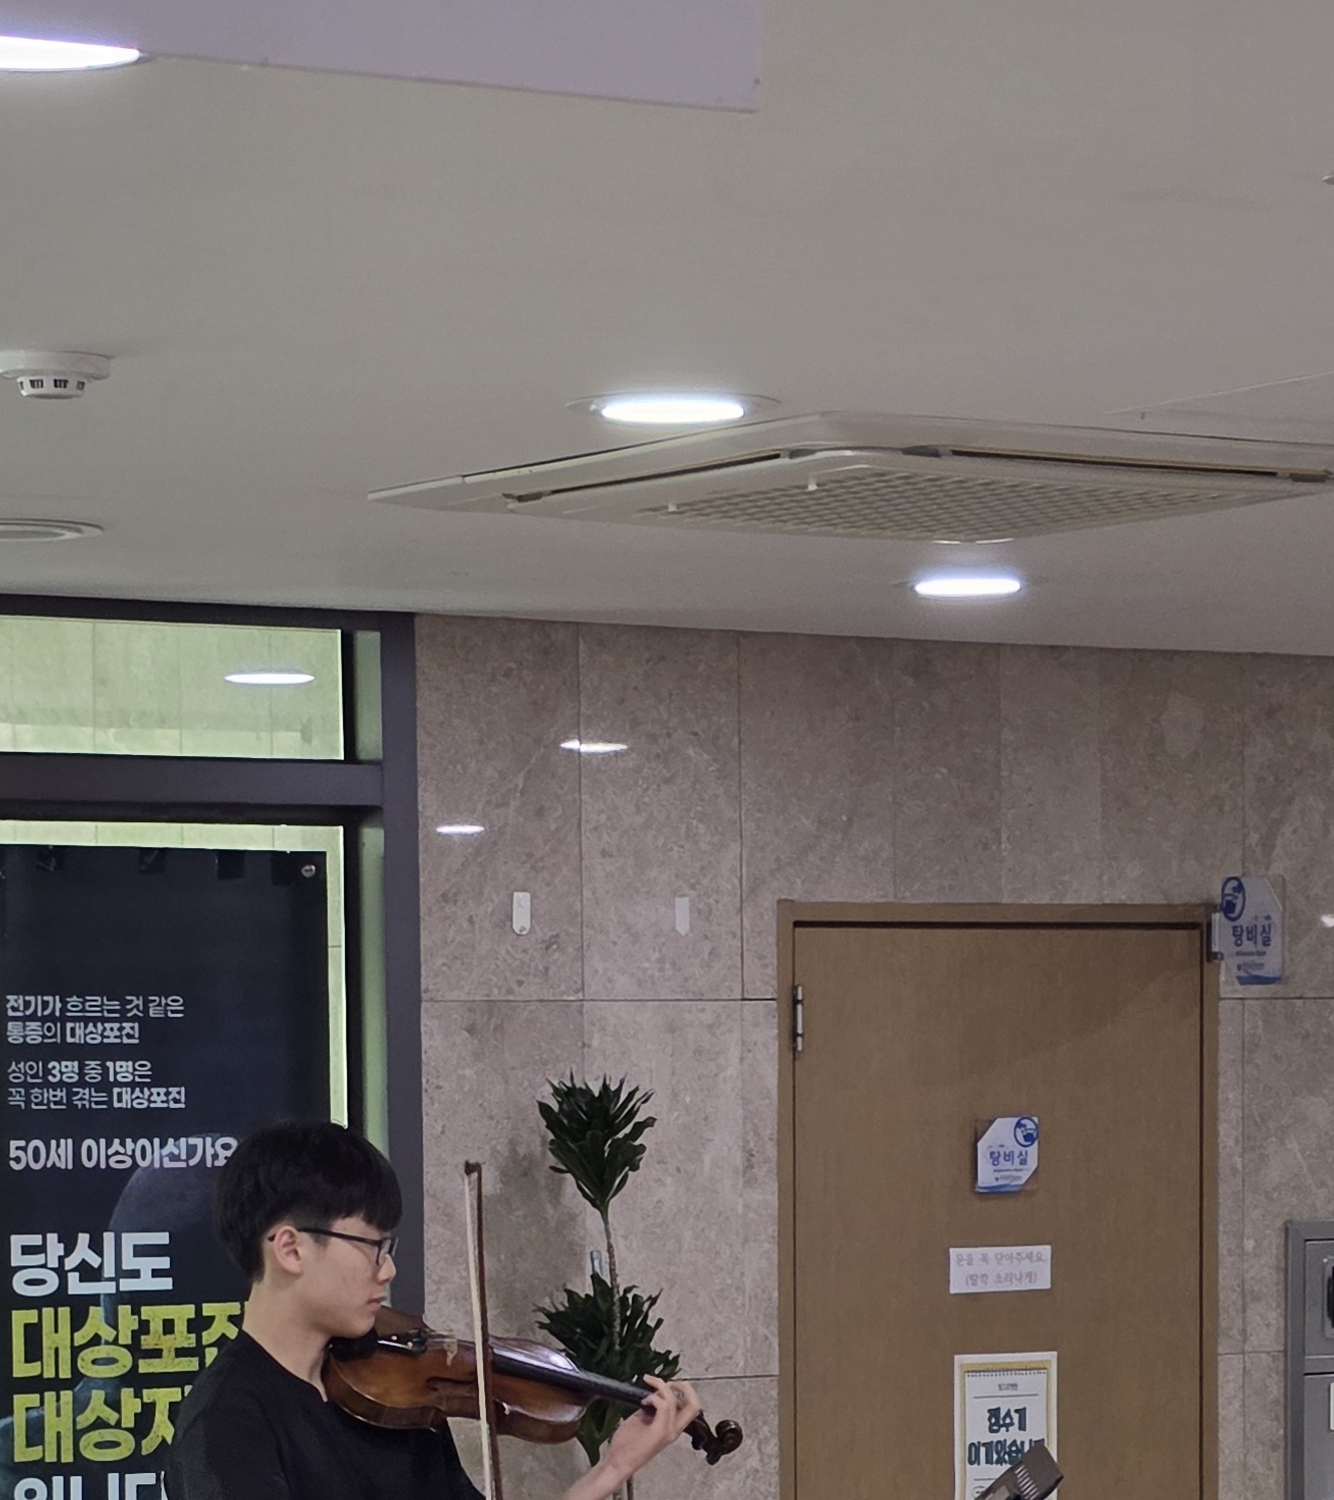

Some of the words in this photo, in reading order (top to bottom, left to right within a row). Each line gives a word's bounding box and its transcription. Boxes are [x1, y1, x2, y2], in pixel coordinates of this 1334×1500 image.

[1232, 923, 1271, 947] 탕비실
[6, 995, 62, 1017] 전기가
[65, 995, 121, 1018] 흐르는
[125, 996, 144, 1018] 것
[148, 996, 185, 1018] 같은
[6, 1021, 61, 1044] 통증의
[66, 1022, 140, 1044] 대상포진
[7, 1061, 43, 1083] 성인
[48, 1061, 79, 1083] 3명
[84, 1061, 103, 1083] 중
[106, 1061, 153, 1083] 1명은
[7, 1088, 25, 1110] 꼭
[29, 1088, 67, 1110] 한번
[71, 1088, 108, 1110] 겪는
[113, 1087, 186, 1109] 대상포진
[8, 1138, 73, 1170] 50세
[81, 1137, 239, 1169] 이상이신가요
[989, 1150, 1028, 1166] 탕비실
[10, 1231, 173, 1297] 당신도
